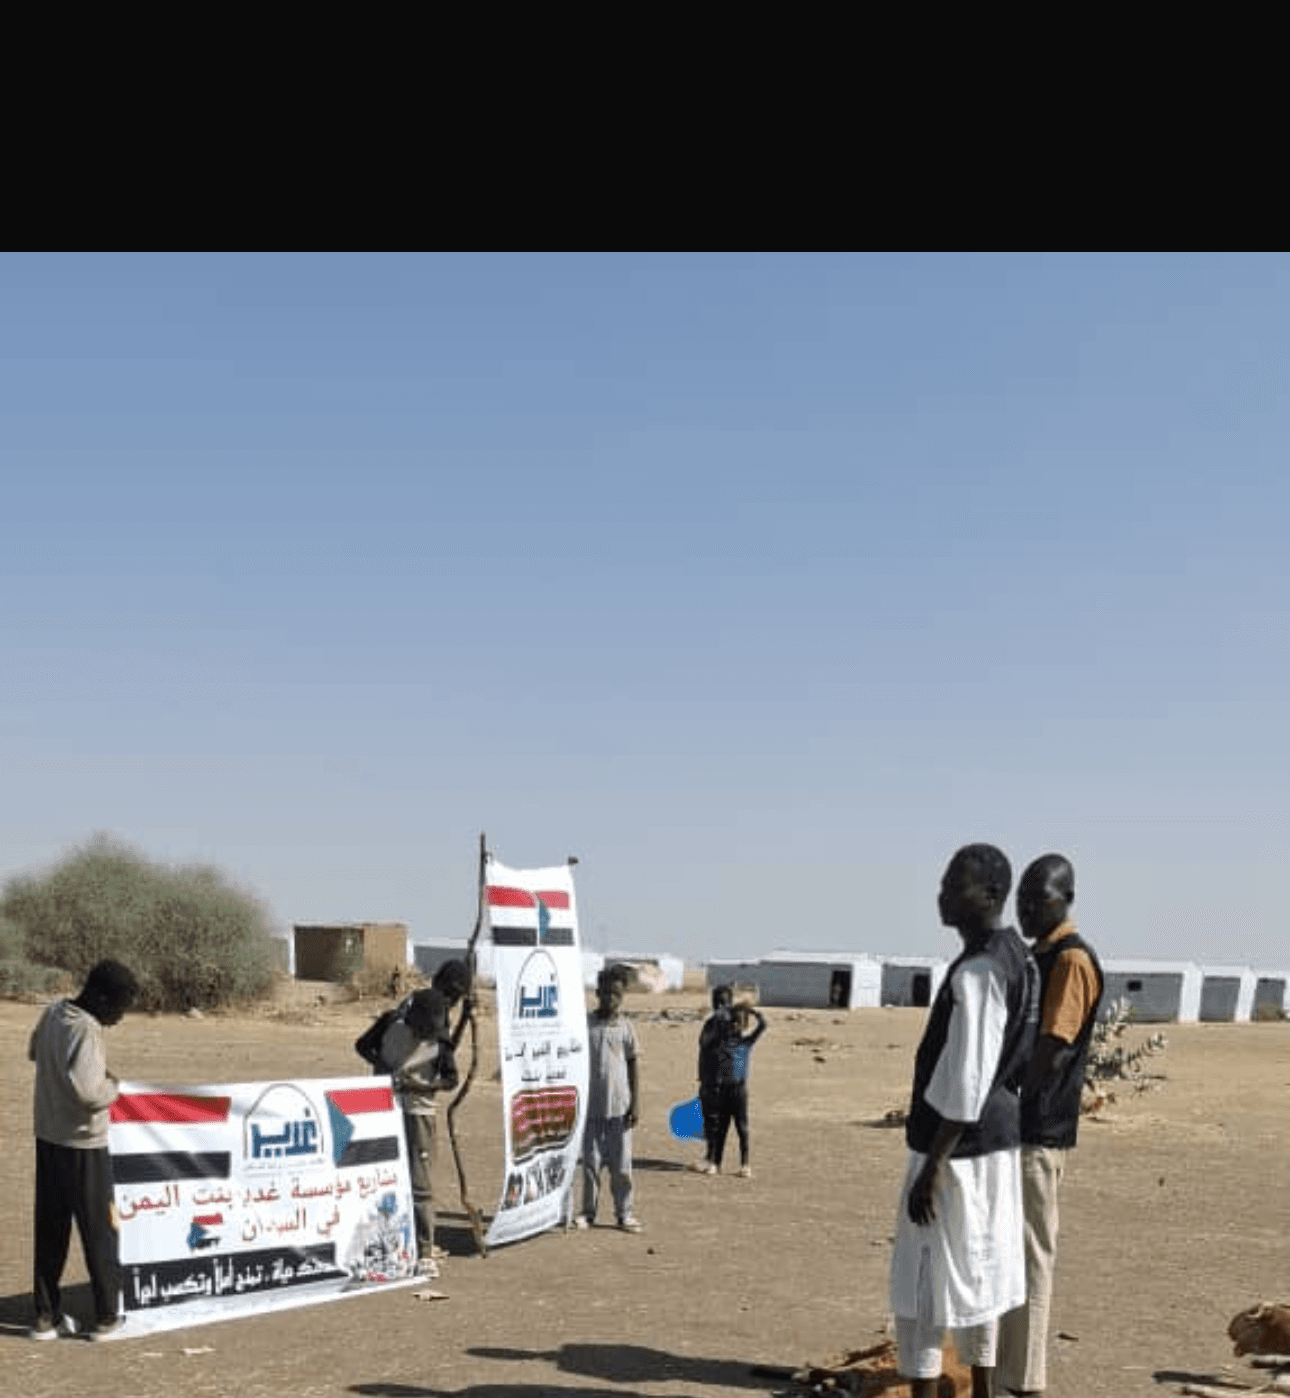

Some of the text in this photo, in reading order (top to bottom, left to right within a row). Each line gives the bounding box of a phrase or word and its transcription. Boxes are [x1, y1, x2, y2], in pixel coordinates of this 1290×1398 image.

[251, 1107, 317, 1158] غدير
[119, 1184, 179, 1220] اليمن
[193, 1187, 233, 1210] بنت
[291, 1176, 351, 1200] مؤسسة
[241, 1204, 341, 1241] في السان
